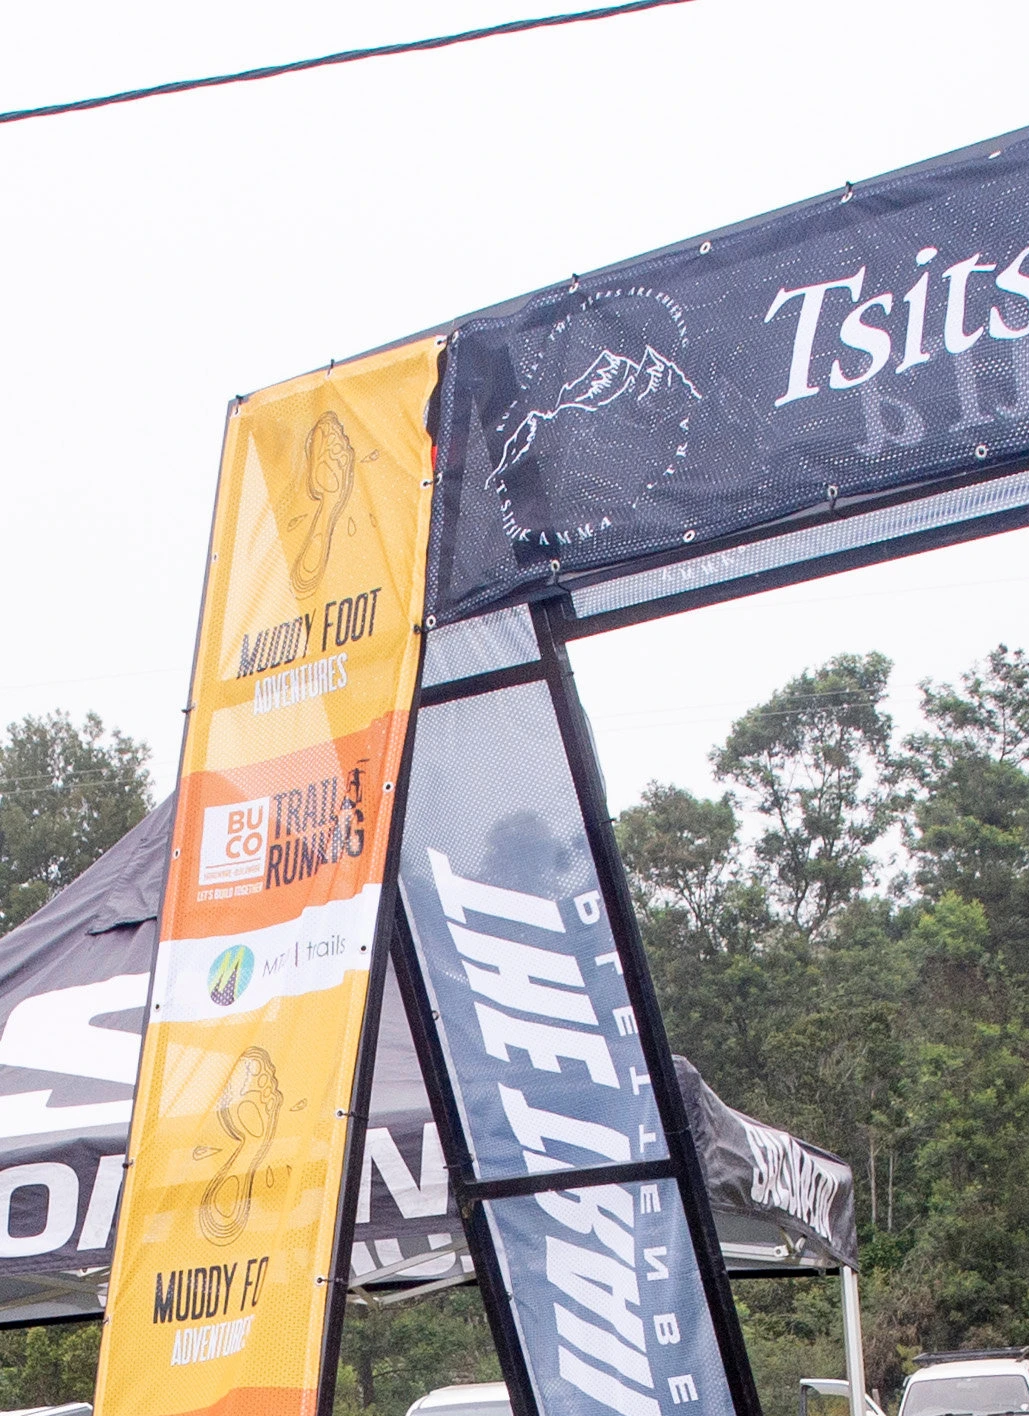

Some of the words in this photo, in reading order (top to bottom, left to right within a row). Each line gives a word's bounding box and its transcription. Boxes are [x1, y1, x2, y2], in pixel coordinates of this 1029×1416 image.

[236, 608, 317, 680] MUDDY
[322, 587, 382, 652] FOOT
[253, 652, 349, 717] ADVENTURES
[225, 831, 263, 859] CO
[227, 806, 264, 835] BU
[263, 952, 291, 978] MT
[306, 934, 346, 961] trails
[152, 1262, 238, 1324] MUDDY
